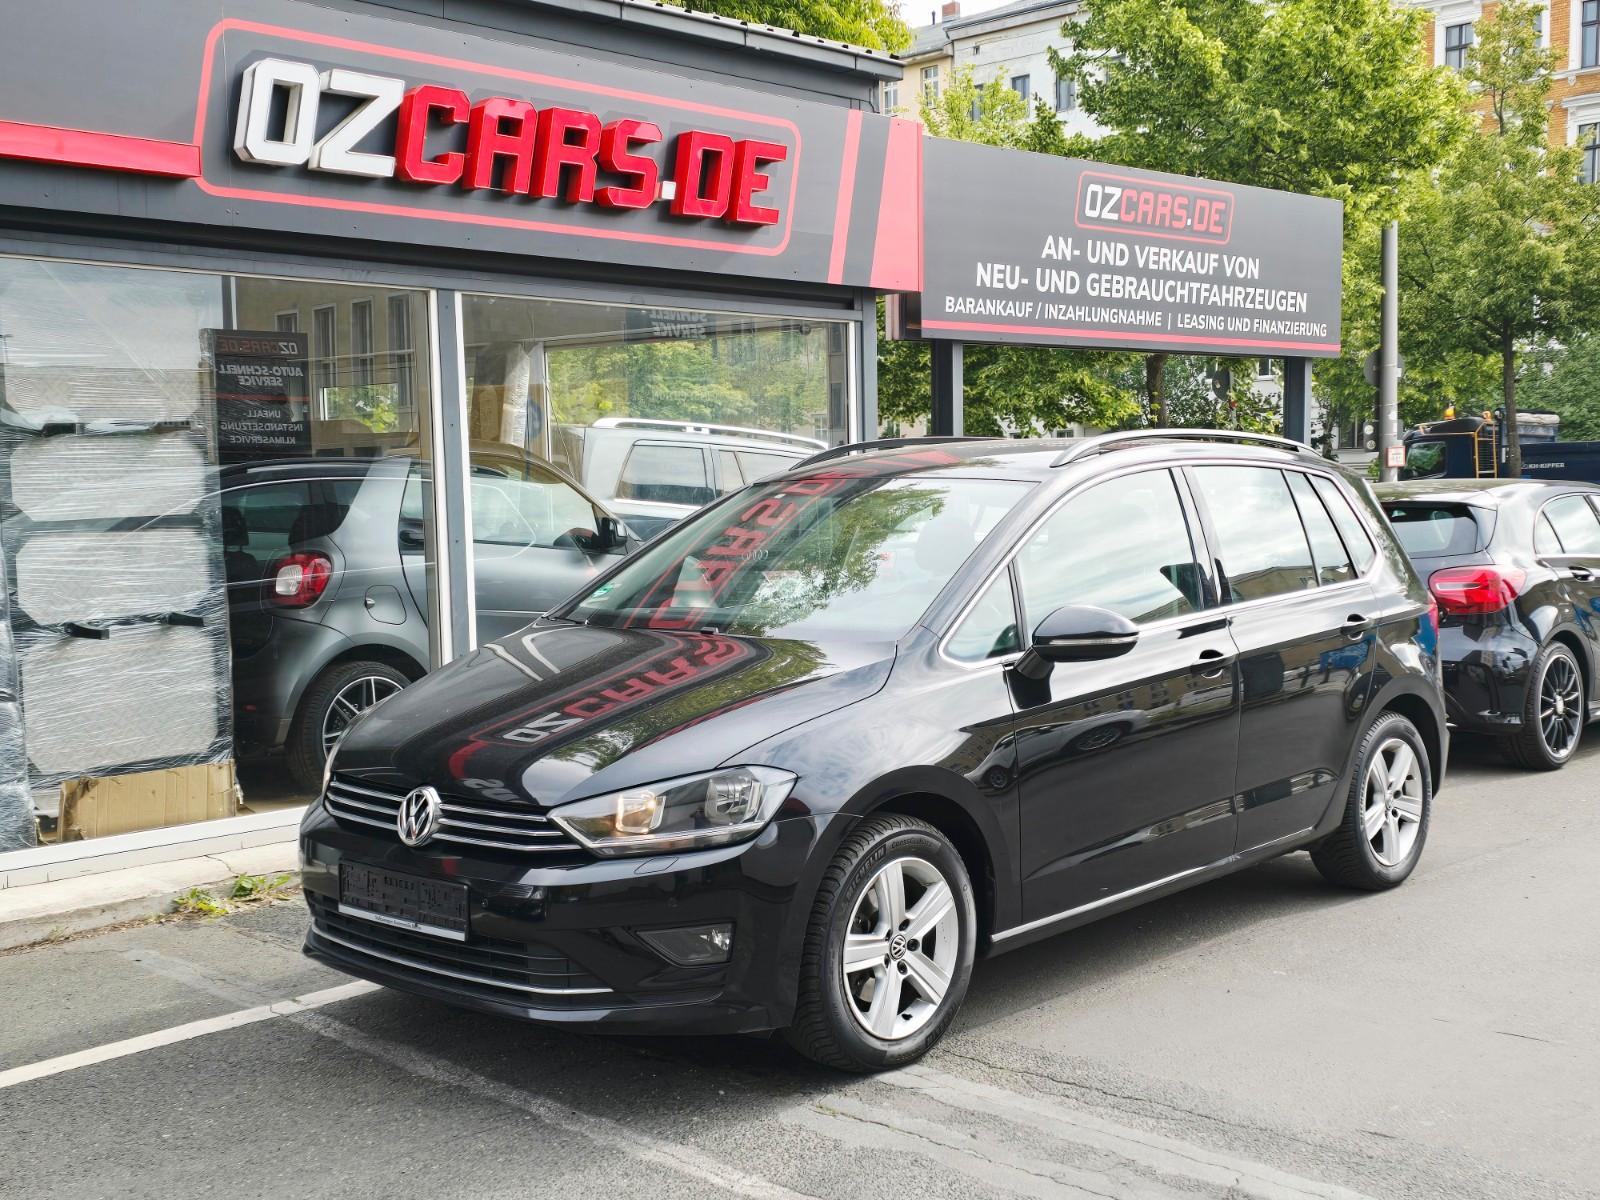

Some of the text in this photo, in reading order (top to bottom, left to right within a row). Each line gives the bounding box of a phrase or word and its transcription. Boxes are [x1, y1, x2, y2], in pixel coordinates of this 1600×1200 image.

[233, 57, 787, 225] OZCARS.DE
[1084, 183, 1226, 234] OZCARS.DE
[1041, 234, 1260, 280] AN- UND VERKAUF VON
[976, 262, 1307, 313] NEU- UND GEBRAUCHTFAHRZEUGEN
[945, 295, 1033, 318] BARANKAUF
[1045, 303, 1162, 327] INZAHLUNGNAHME
[1177, 313, 1224, 331] LEASING
[1227, 317, 1250, 332] UND
[1253, 318, 1327, 337] FINANZIERUNG
